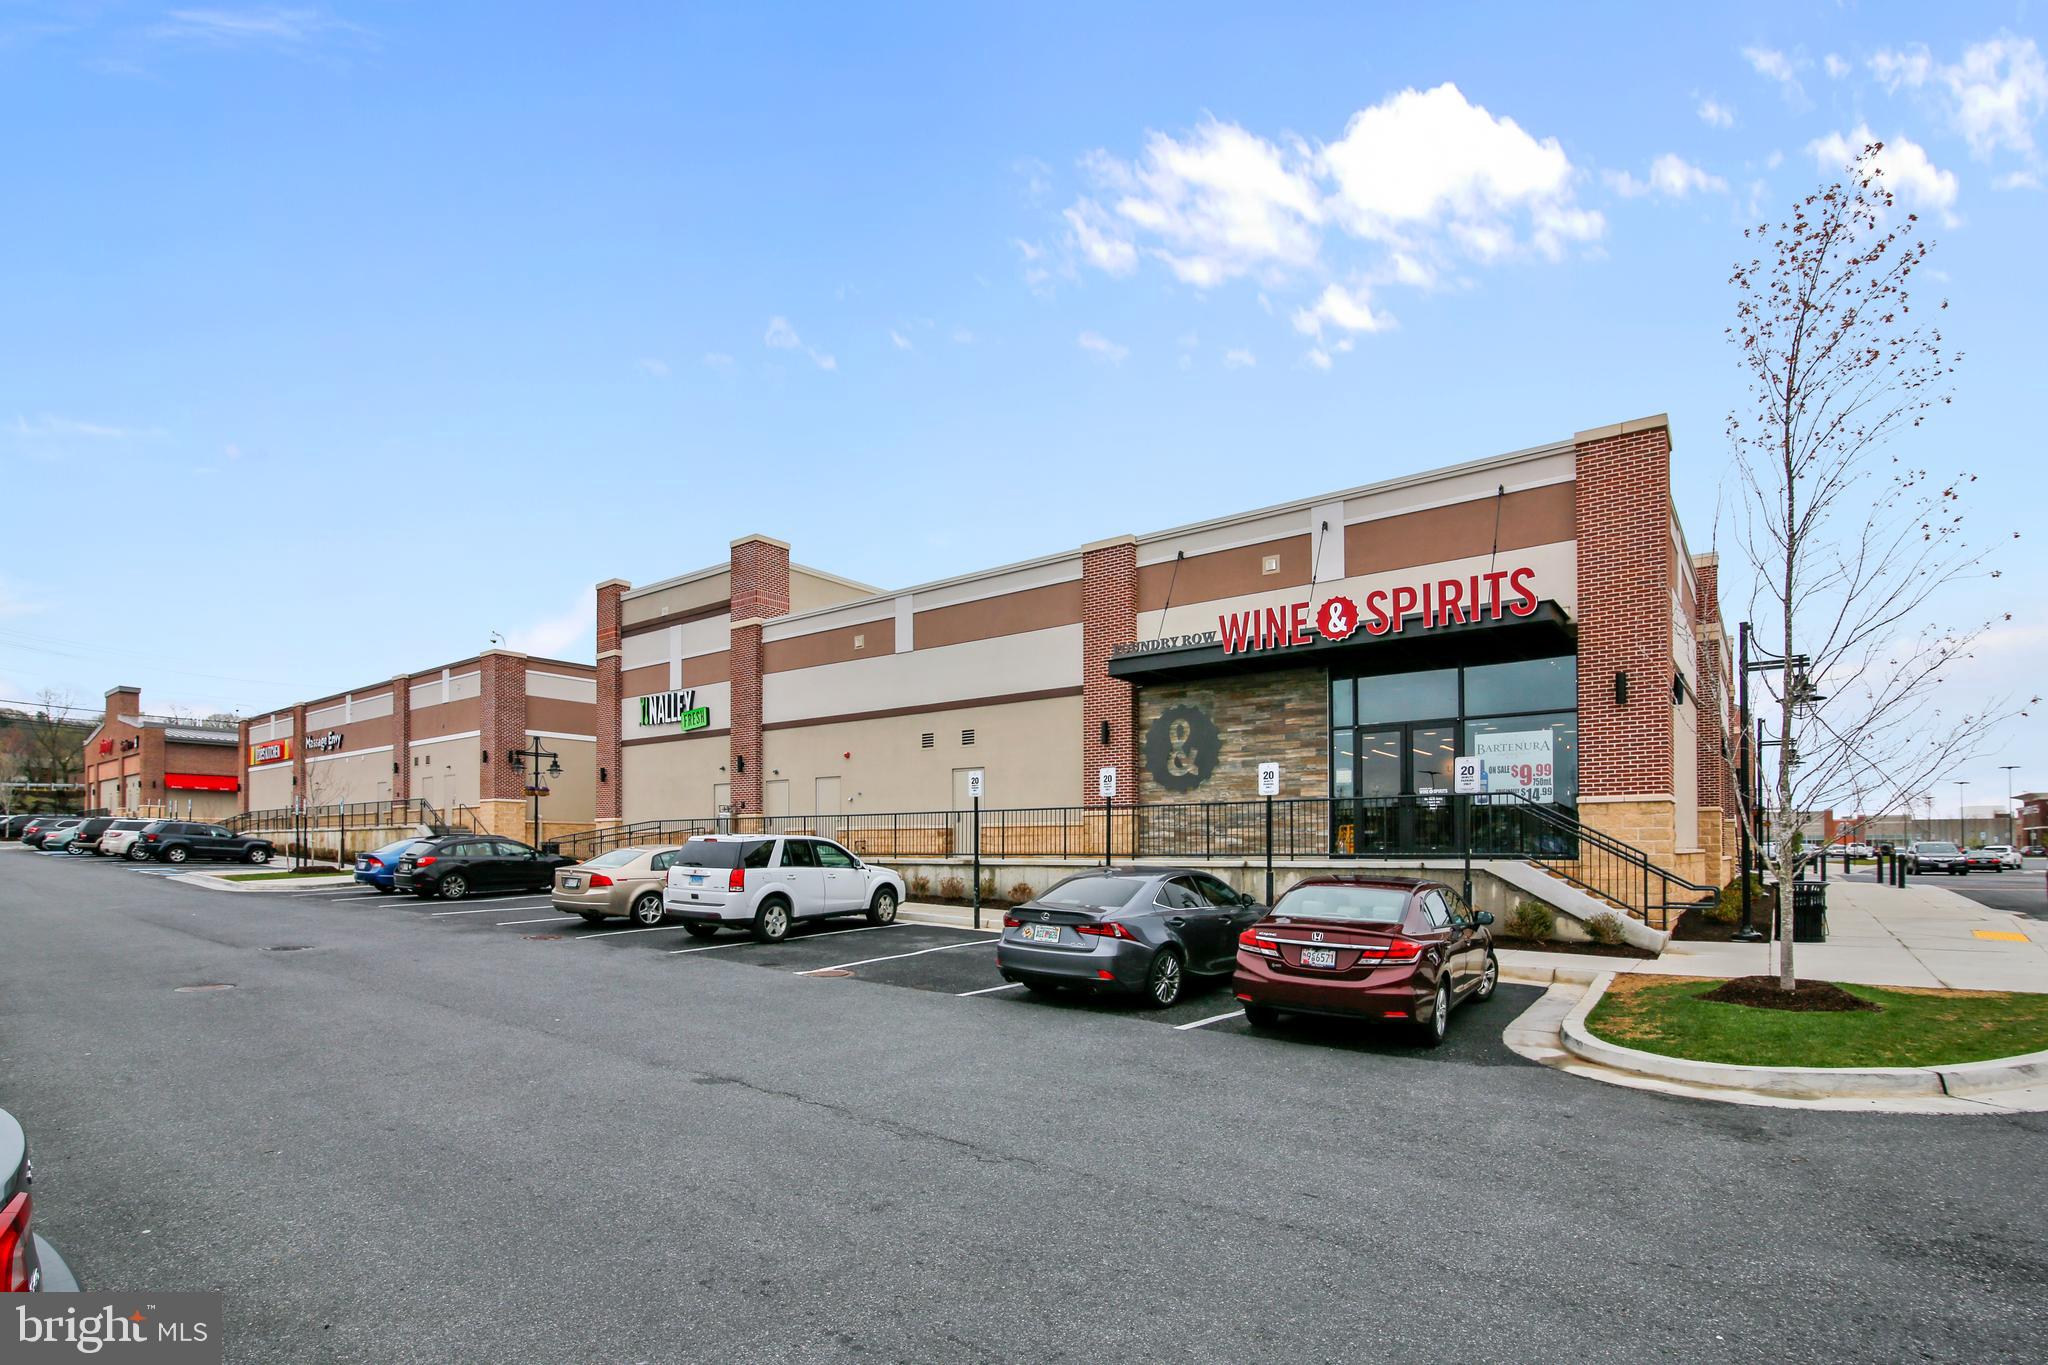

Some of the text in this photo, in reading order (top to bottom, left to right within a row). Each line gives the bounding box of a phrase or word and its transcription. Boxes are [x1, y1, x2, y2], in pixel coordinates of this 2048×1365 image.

[1181, 630, 1217, 647] ROW
[1218, 601, 1313, 655] WINE
[1327, 601, 1348, 634] &
[1365, 566, 1539, 636] SPIRITS
[649, 689, 694, 726] NALLEY
[683, 709, 705, 728] FRESH
[306, 730, 343, 751] Massage Envy
[1168, 718, 1199, 777] &
[1477, 740, 1550, 755] BARTENURA
[1103, 774, 1113, 783] 20
[1263, 770, 1274, 780] 20
[1460, 765, 1475, 776] 20
[1488, 763, 1552, 786] ON SALE $9.99
[970, 776, 980, 785] 20
